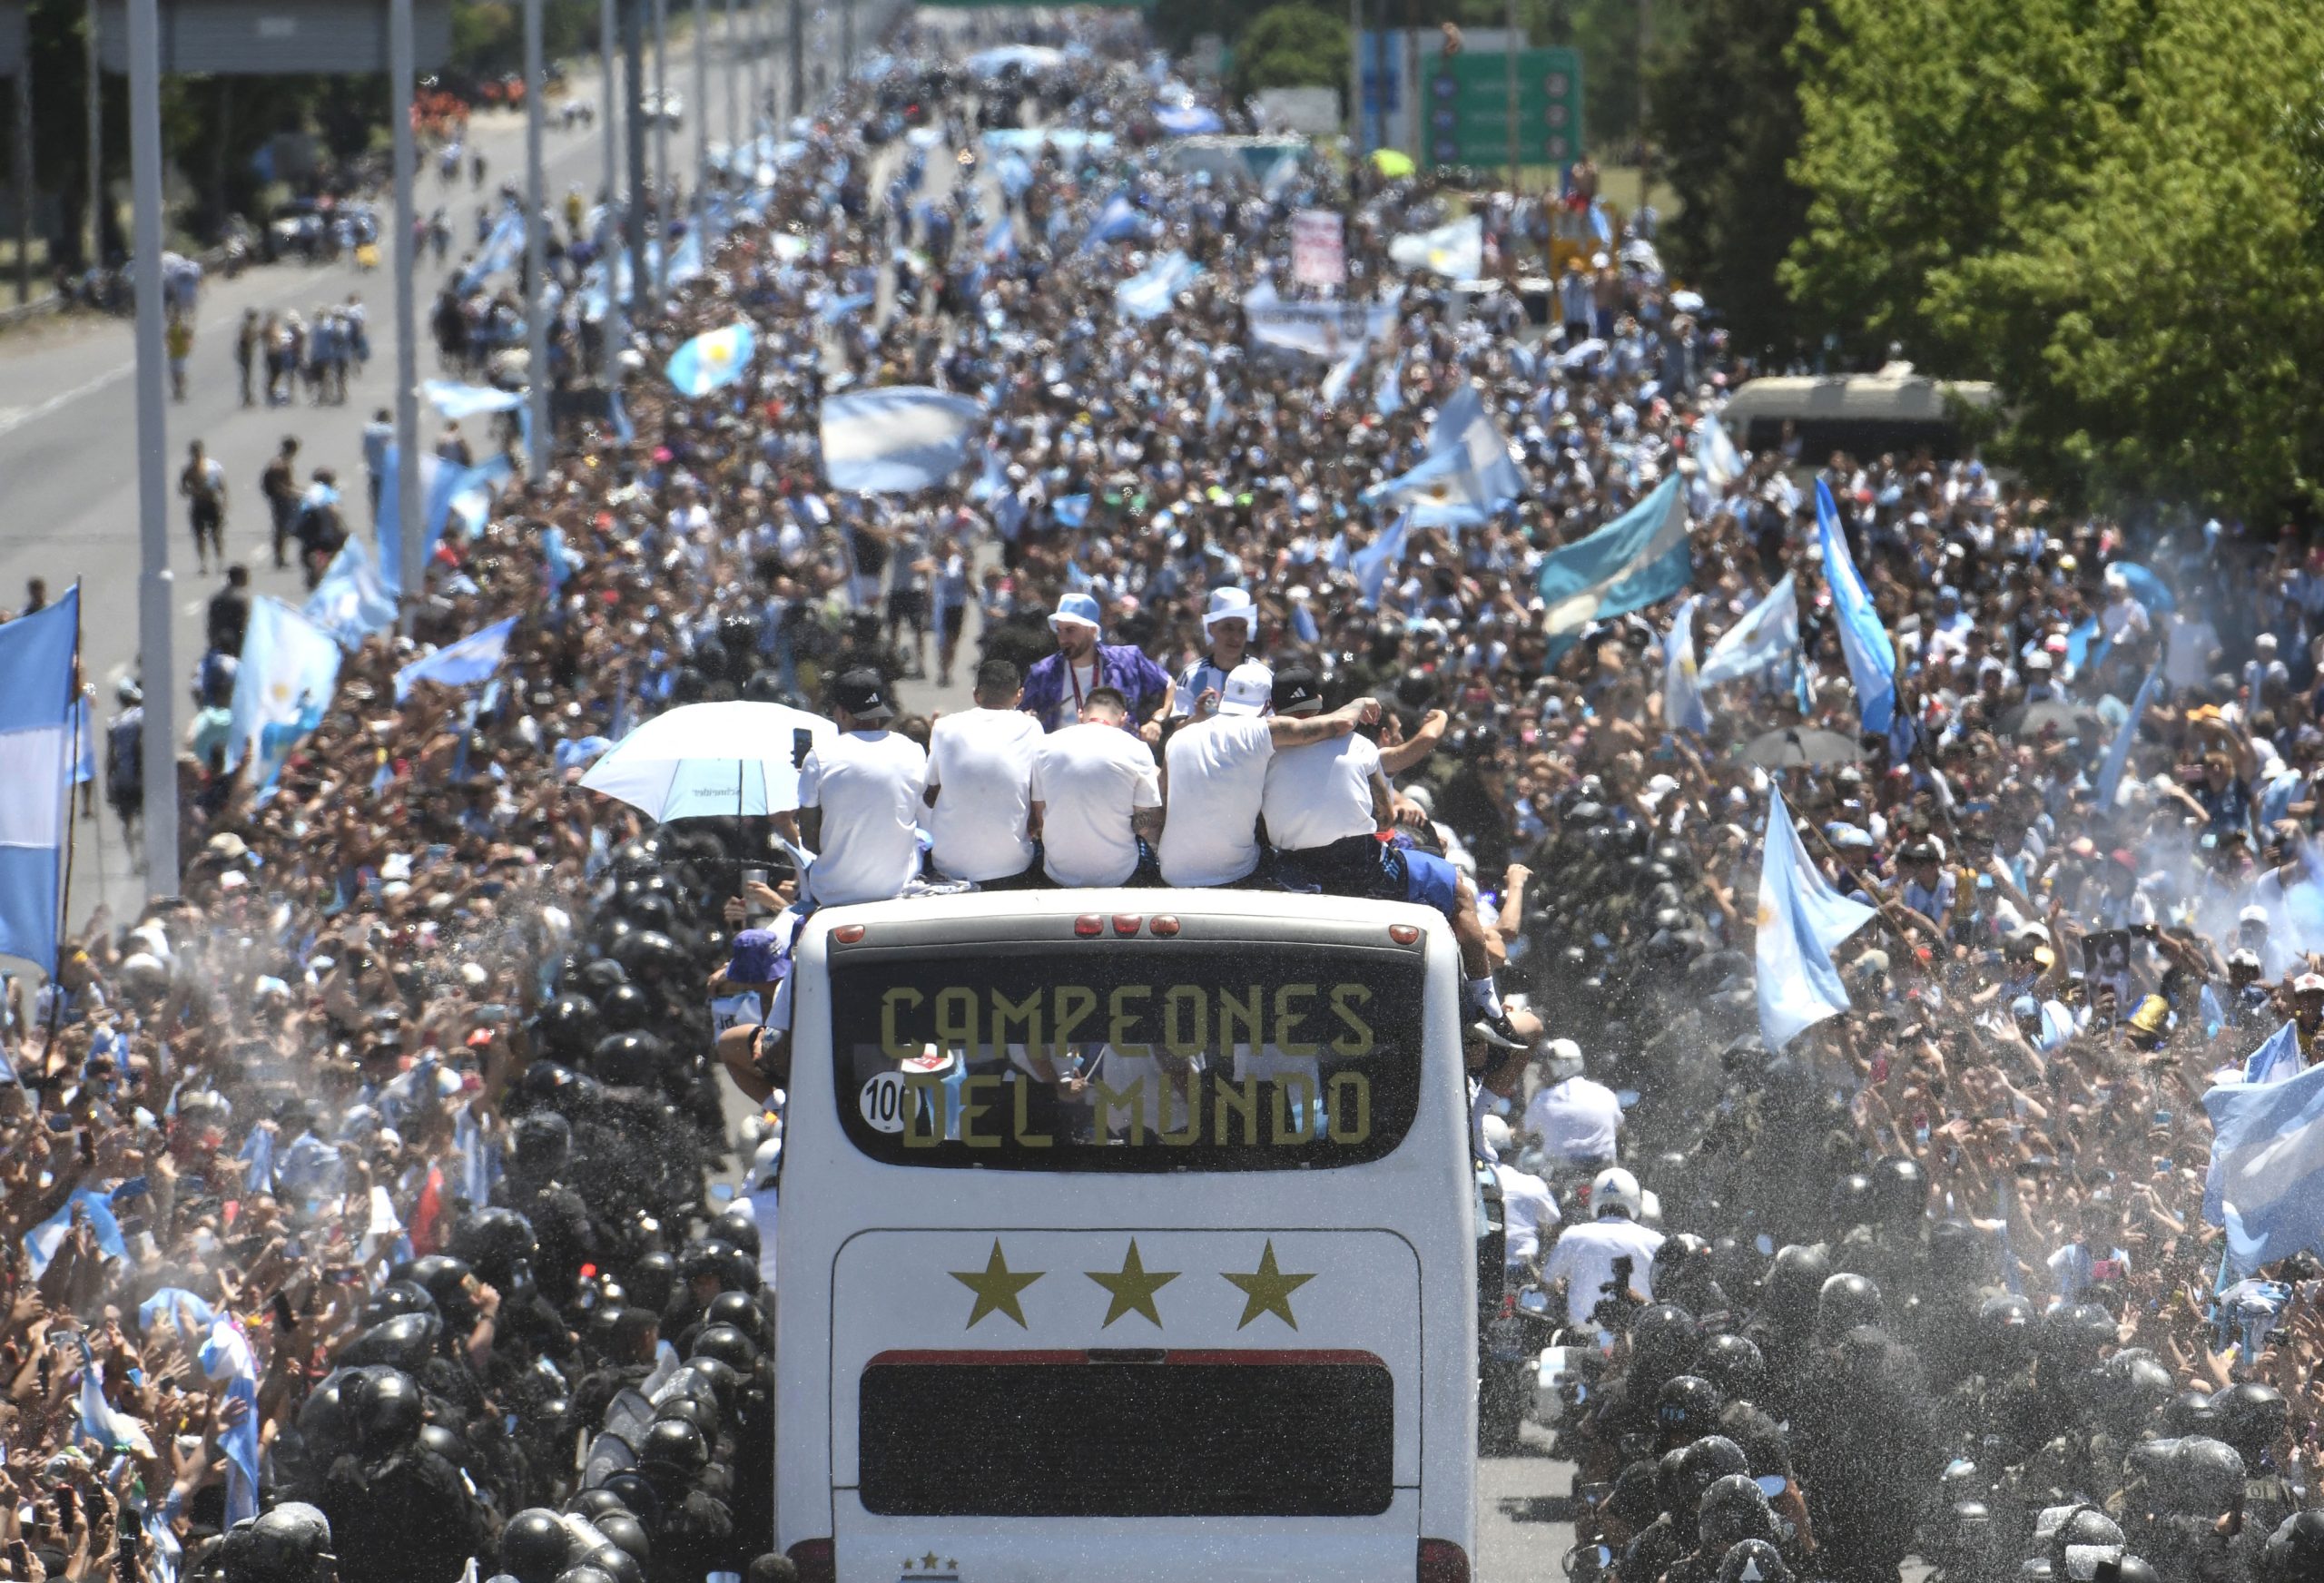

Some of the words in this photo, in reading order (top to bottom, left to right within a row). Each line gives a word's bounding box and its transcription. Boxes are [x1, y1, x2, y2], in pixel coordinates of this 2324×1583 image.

[881, 984, 1374, 1059] CAMPEONES
[903, 1074, 1053, 1147] DEL
[1094, 1071, 1371, 1146] MUNDO
